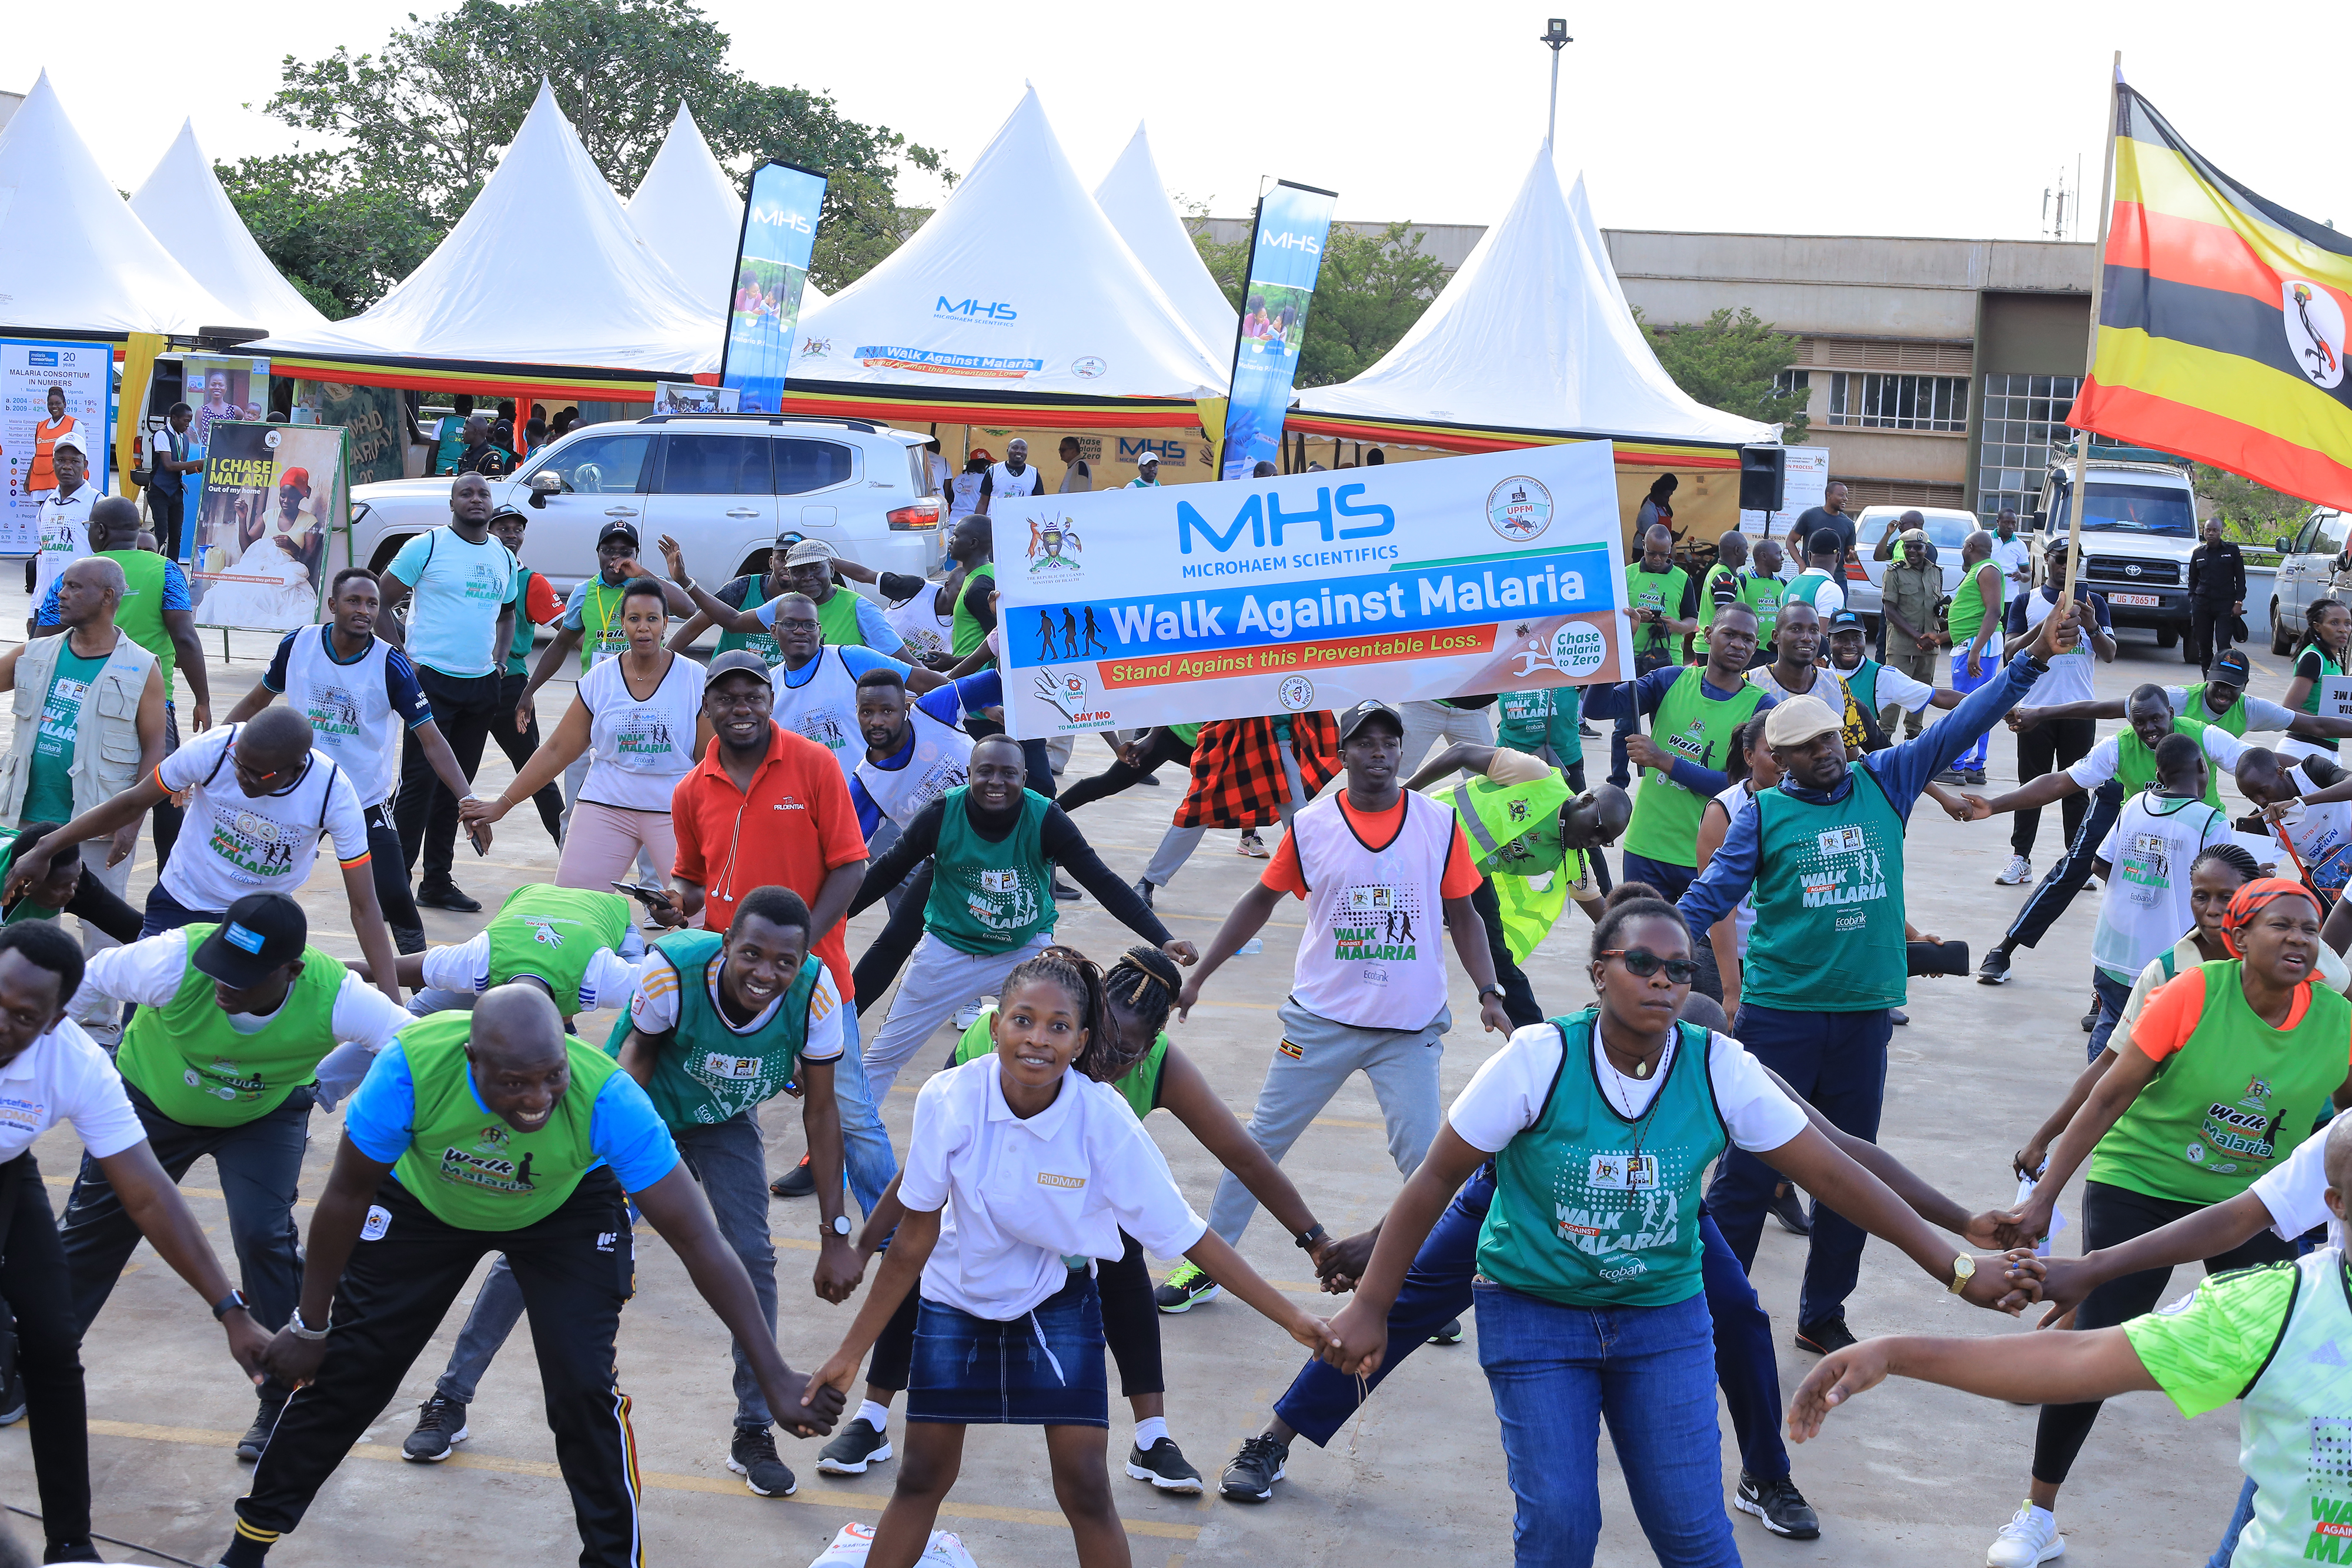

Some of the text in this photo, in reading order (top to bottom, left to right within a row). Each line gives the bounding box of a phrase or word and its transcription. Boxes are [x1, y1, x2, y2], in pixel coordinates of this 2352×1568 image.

[753, 208, 811, 234] MHS
[1262, 229, 1319, 255] MHS
[936, 296, 1017, 320] MHS
[934, 314, 1014, 327] MICROHAEM SCIENTIFICS
[731, 336, 756, 344] Malaria
[63, 353, 75, 361] 20
[888, 347, 1034, 369] Walk Against Malaria
[894, 362, 926, 371] Against
[946, 367, 997, 377] Preventable
[1238, 362, 1263, 371] Malaria
[1120, 438, 1185, 459] MHS
[211, 458, 282, 474] I CHASED
[209, 472, 279, 487] MALARIA
[1507, 505, 1533, 514] UPFM
[1177, 483, 1395, 555] MHS
[1182, 545, 1399, 579] MICROHAEM SCIENTIFICS
[1110, 564, 1585, 644] Walk Against Malaria
[1639, 593, 1661, 601] Walk
[2117, 594, 2126, 603] UG
[2131, 596, 2149, 604] 7865
[1558, 631, 1599, 646] Chase
[745, 641, 773, 652] WALK
[1557, 643, 1600, 656] Malaria
[1112, 633, 1482, 683] Stand Against this Preventable Loss.
[1559, 654, 1600, 667] to Zero
[1282, 683, 1291, 706] MALARIA
[1302, 683, 1311, 705] UGANDA
[2333, 690, 2348, 700] ME
[1505, 700, 1531, 709] WALK
[308, 708, 335, 720] WALK
[1074, 711, 1111, 723] SAY NO
[1507, 707, 1558, 720] MALARIA
[1526, 722, 1545, 730] Ecobank
[320, 735, 342, 744] Ecobank
[1669, 734, 1702, 754] Walk
[38, 741, 63, 754] Ecobank
[619, 744, 671, 753] MALARIA
[1678, 750, 1699, 760] AGAINST
[213, 824, 255, 855] WALK
[2302, 829, 2314, 840] DTB
[2316, 835, 2325, 844] 5TH
[218, 838, 237, 852] AGAINST
[209, 837, 291, 876] MALARIA
[2123, 858, 2148, 871] WALK
[230, 871, 263, 885] Ecobank
[1800, 869, 1847, 887] WALK
[2122, 870, 2169, 889] MALARIA
[1803, 882, 1887, 907] MALARIA
[2131, 892, 2153, 902] Ecobank
[967, 892, 1004, 915] WALK
[973, 907, 989, 915] AGAINST
[968, 908, 1038, 929] MALARIA
[1836, 911, 1867, 926] Ecobank
[983, 932, 1013, 942] Ecobank
[1333, 927, 1377, 940] WALK
[1335, 944, 1416, 960] MALARIA
[1364, 969, 1389, 982] Ecobank
[2209, 1103, 2267, 1130] Walk
[2200, 1129, 2209, 1138] SAY
[2203, 1119, 2273, 1156] Malaria
[2227, 1126, 2261, 1138] AGAINST
[444, 1148, 514, 1174] Walk
[442, 1161, 533, 1190] Malaria
[470, 1166, 511, 1180] AGAINST
[1040, 1174, 1083, 1187] RIDMAL
[1555, 1202, 1624, 1230] WALK
[1564, 1223, 1596, 1235] AGAINST
[1557, 1224, 1677, 1256] MALARIA
[1603, 1255, 1620, 1263] Official
[1599, 1258, 1648, 1279] Ecobank
